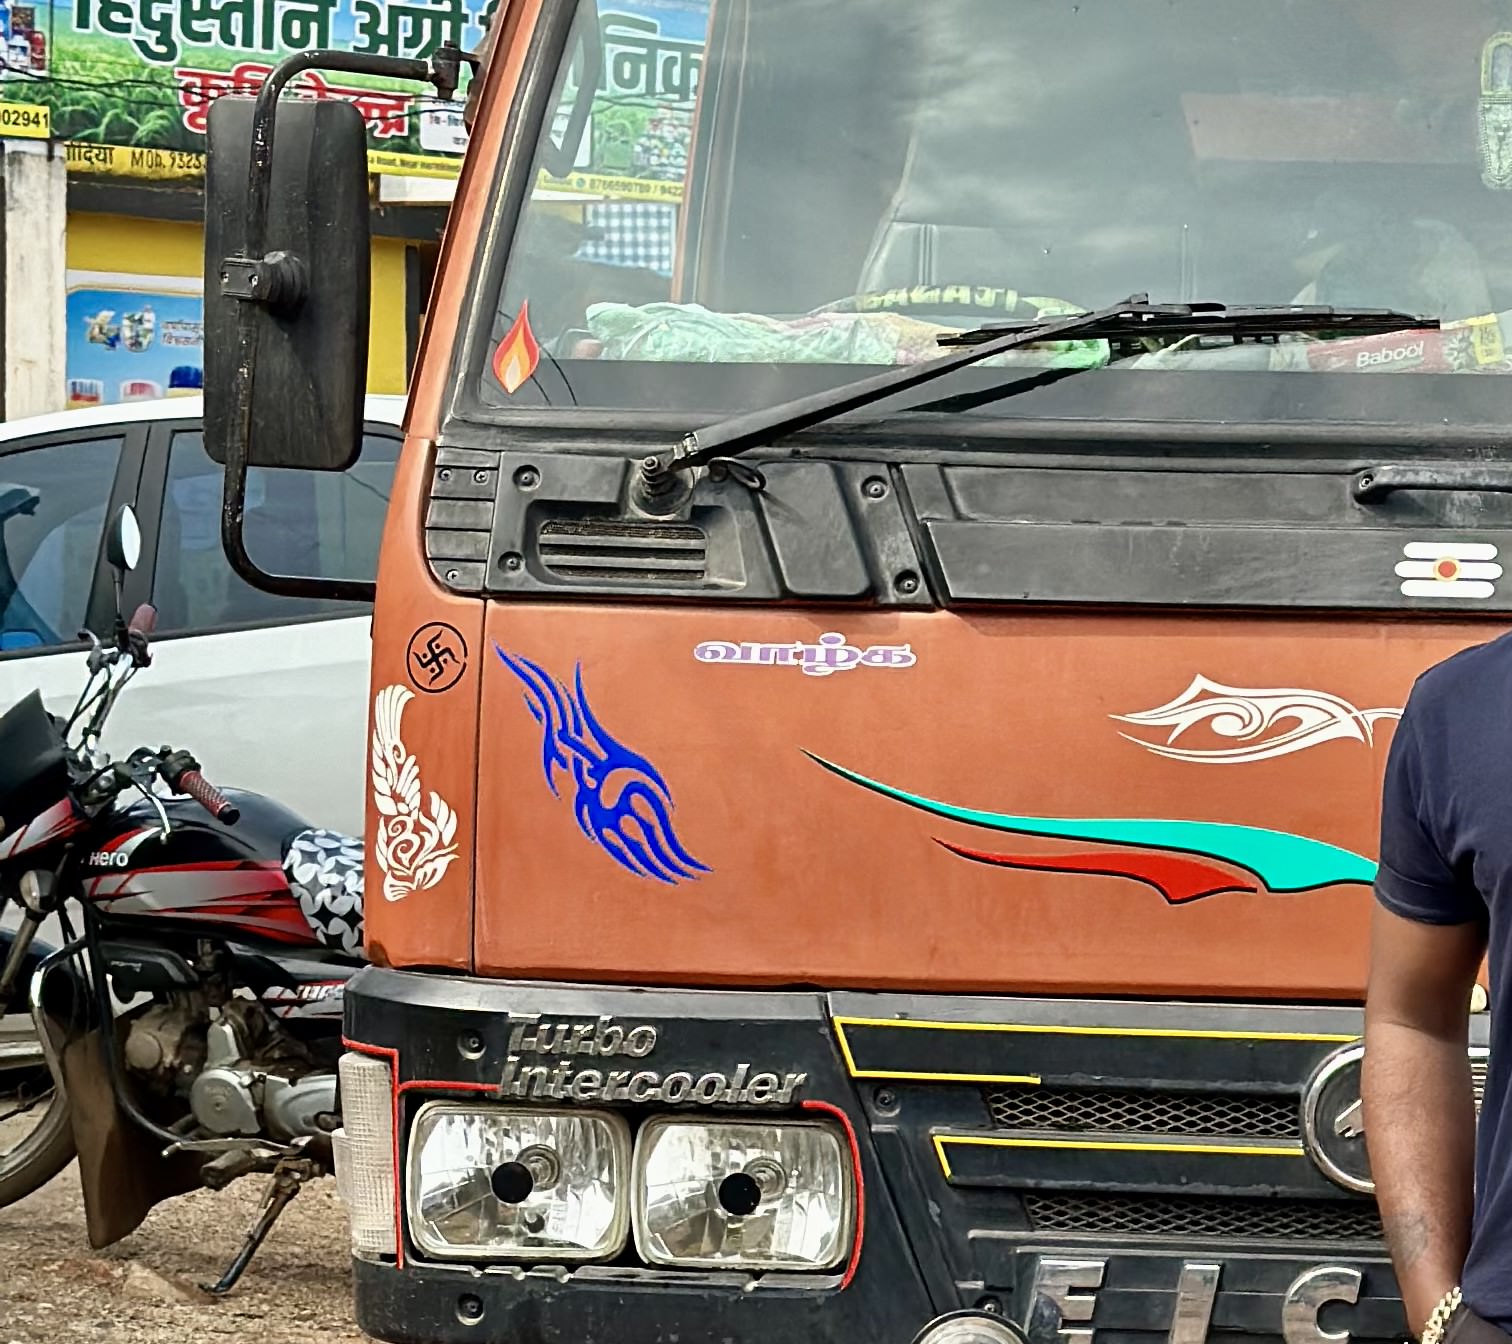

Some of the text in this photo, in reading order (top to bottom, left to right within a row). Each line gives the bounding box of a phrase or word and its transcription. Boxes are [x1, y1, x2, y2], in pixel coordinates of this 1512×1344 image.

[0, 109, 49, 129] 02941
[1356, 341, 1424, 367] Babool
[694, 632, 917, 676] வாழ்க
[507, 1011, 657, 1057] Turbo
[500, 1056, 807, 1105] Intercooler
